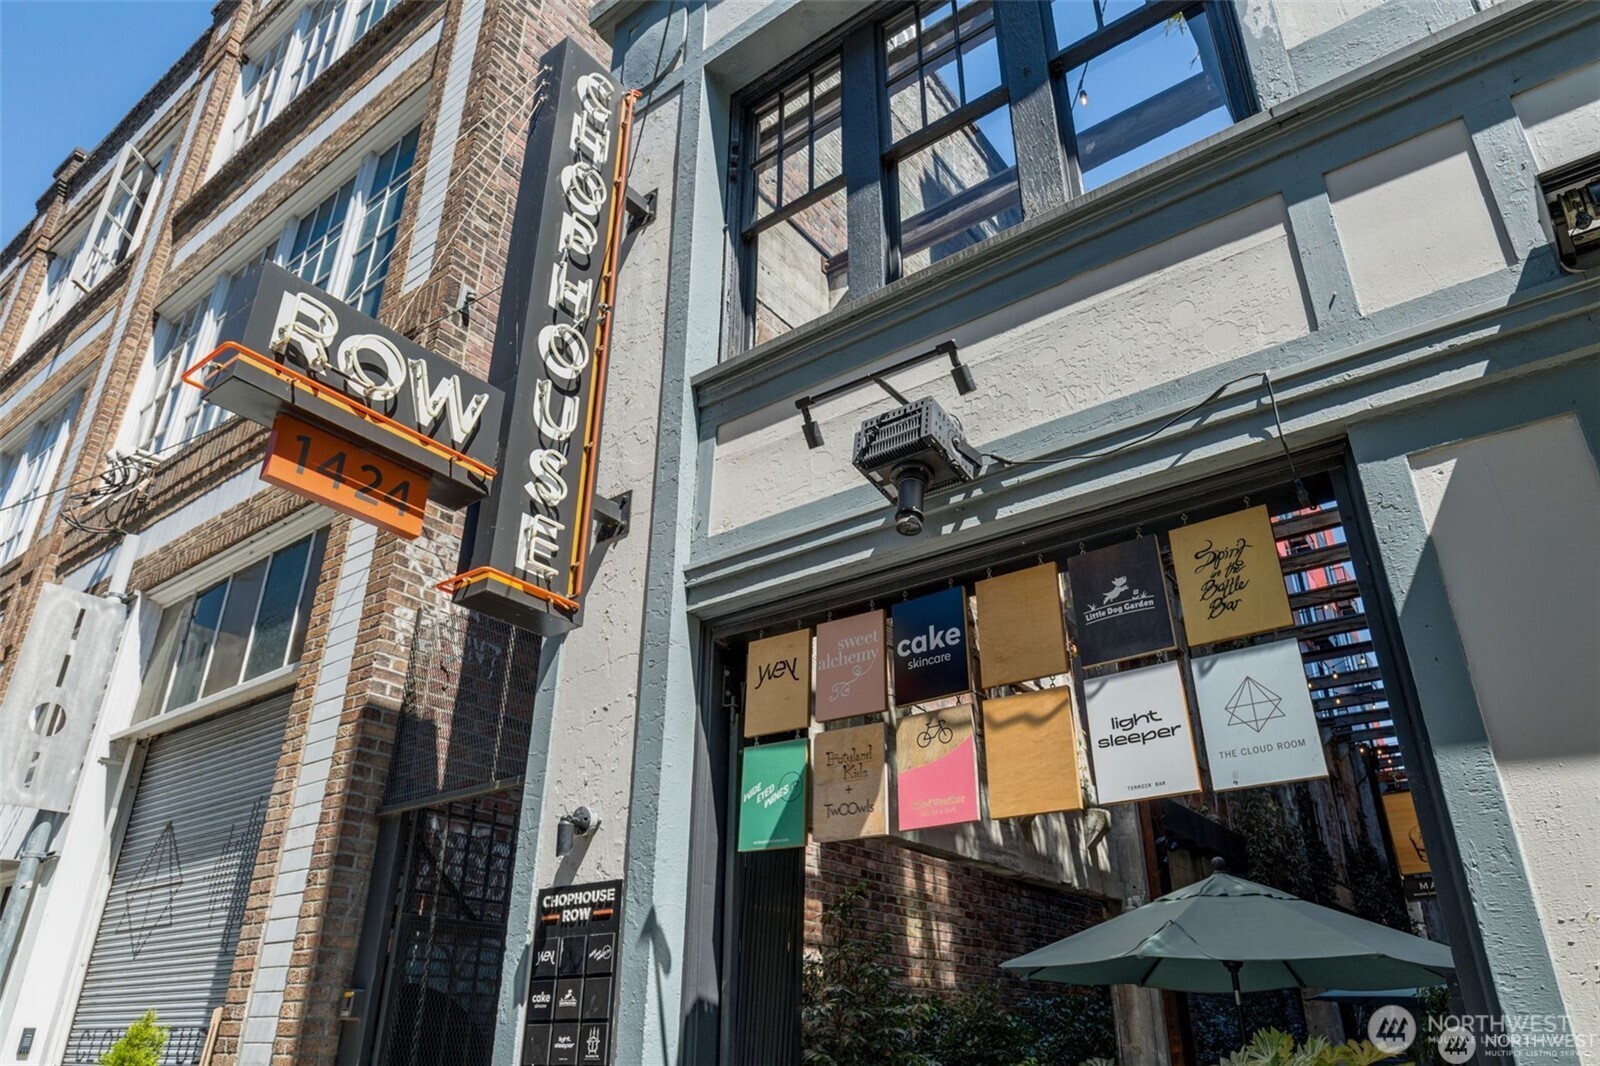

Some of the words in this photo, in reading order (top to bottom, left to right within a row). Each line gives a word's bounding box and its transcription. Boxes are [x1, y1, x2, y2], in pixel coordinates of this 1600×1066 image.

[515, 72, 615, 580] CHOPHOUSE
[269, 290, 489, 445] ROW
[295, 435, 411, 517] 1424
[1194, 538, 1253, 574] Spirit
[1225, 560, 1246, 578] the
[1200, 575, 1250, 602] Bottle
[1085, 609, 1107, 622] Little
[1107, 606, 1123, 615] Dog
[1124, 599, 1154, 611] Garden
[1207, 597, 1243, 620] Bar
[837, 629, 880, 651] sweet
[897, 624, 961, 658] cake
[818, 647, 880, 671] alchemy
[907, 652, 952, 670] skincare
[1111, 710, 1163, 732] light
[1098, 723, 1182, 749] sleeper
[1219, 749, 1238, 760] THE
[1240, 744, 1274, 757] CLOUD
[1277, 738, 1307, 751] ROOM
[542, 888, 616, 909] CHOPHOUSE
[562, 907, 592, 923] ROW
[531, 991, 551, 1004] cake
